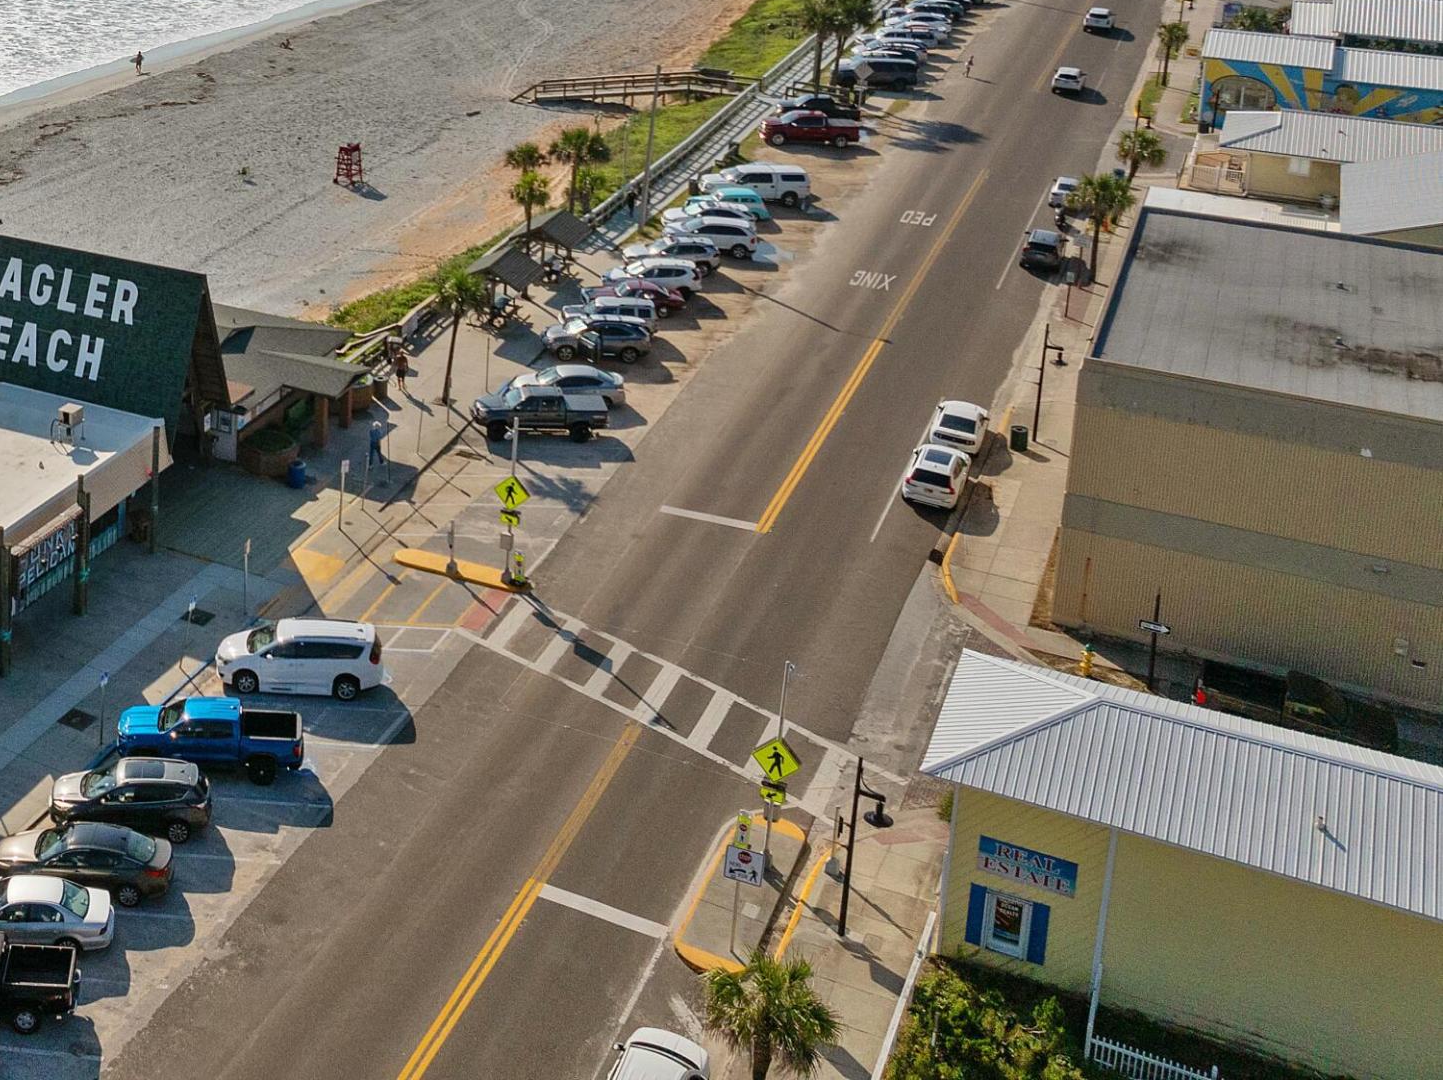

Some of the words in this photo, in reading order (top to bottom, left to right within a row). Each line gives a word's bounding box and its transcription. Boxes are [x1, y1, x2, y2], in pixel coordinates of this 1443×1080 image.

[899, 209, 937, 227] PED
[848, 270, 897, 291] XING
[19, 539, 76, 589] PELICAN
[982, 856, 1071, 894] ESTATE
[995, 842, 1061, 876] REAL
